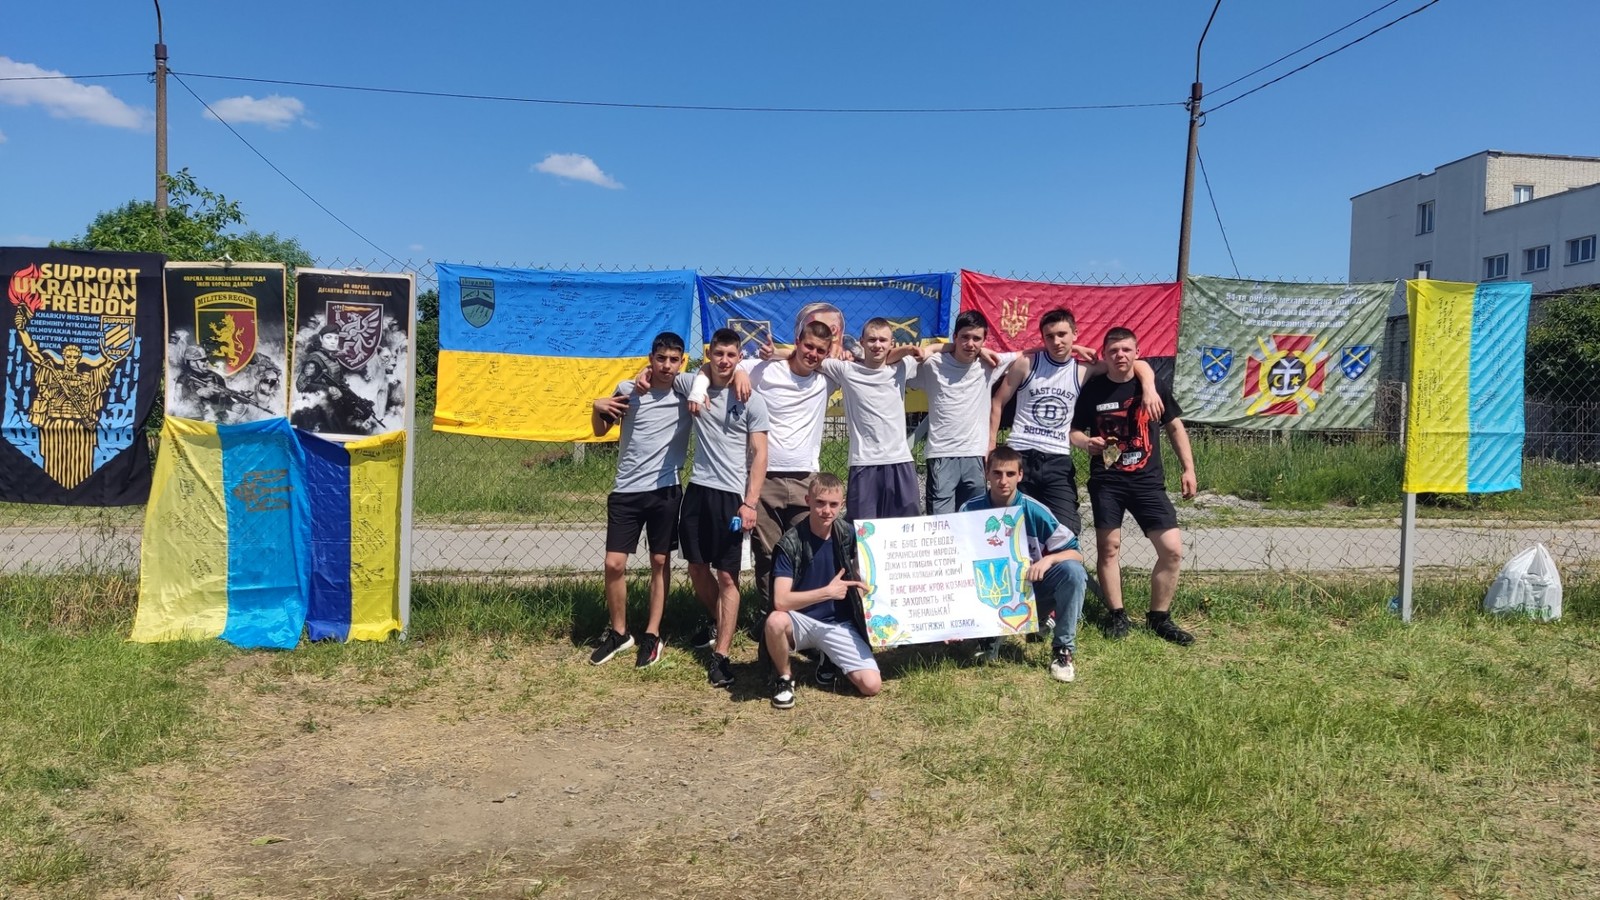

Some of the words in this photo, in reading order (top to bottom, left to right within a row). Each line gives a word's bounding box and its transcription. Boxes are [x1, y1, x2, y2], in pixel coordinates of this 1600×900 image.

[40, 263, 140, 285] SUPPORT
[14, 276, 137, 300] UKRAINIAN
[734, 281, 785, 299] ОКРЕМА
[887, 279, 940, 300] БРИГАДА
[40, 294, 137, 316] FREEDOM
[197, 293, 228, 306] MILITES
[228, 293, 254, 306] REGUM
[30, 319, 64, 327] CHERNIHIV
[65, 321, 100, 329] MYKOLAIV
[35, 312, 66, 320] KHARKIV
[66, 314, 100, 322] HOSTOMEL
[103, 317, 133, 325] SUPPORT
[26, 326, 71, 335] VOLNOVAKHA
[72, 330, 104, 338] MARIUPOL
[32, 334, 68, 343] OKHTYRKA
[69, 337, 100, 345] KHERSON
[1029, 387, 1050, 397] EAST
[1051, 387, 1075, 401] COAST
[1044, 404, 1057, 420] B
[1023, 425, 1066, 440] BROOKLYN
[923, 519, 951, 532] ГРУПА
[889, 540, 898, 549] НЕ
[901, 538, 918, 549] БУДЕ
[921, 535, 955, 547] ПЕРЕВОДУ
[896, 585, 907, 594] НАС
[928, 582, 945, 592] КРОВ
[890, 598, 898, 607] НЕ
[942, 592, 955, 602] НАС
